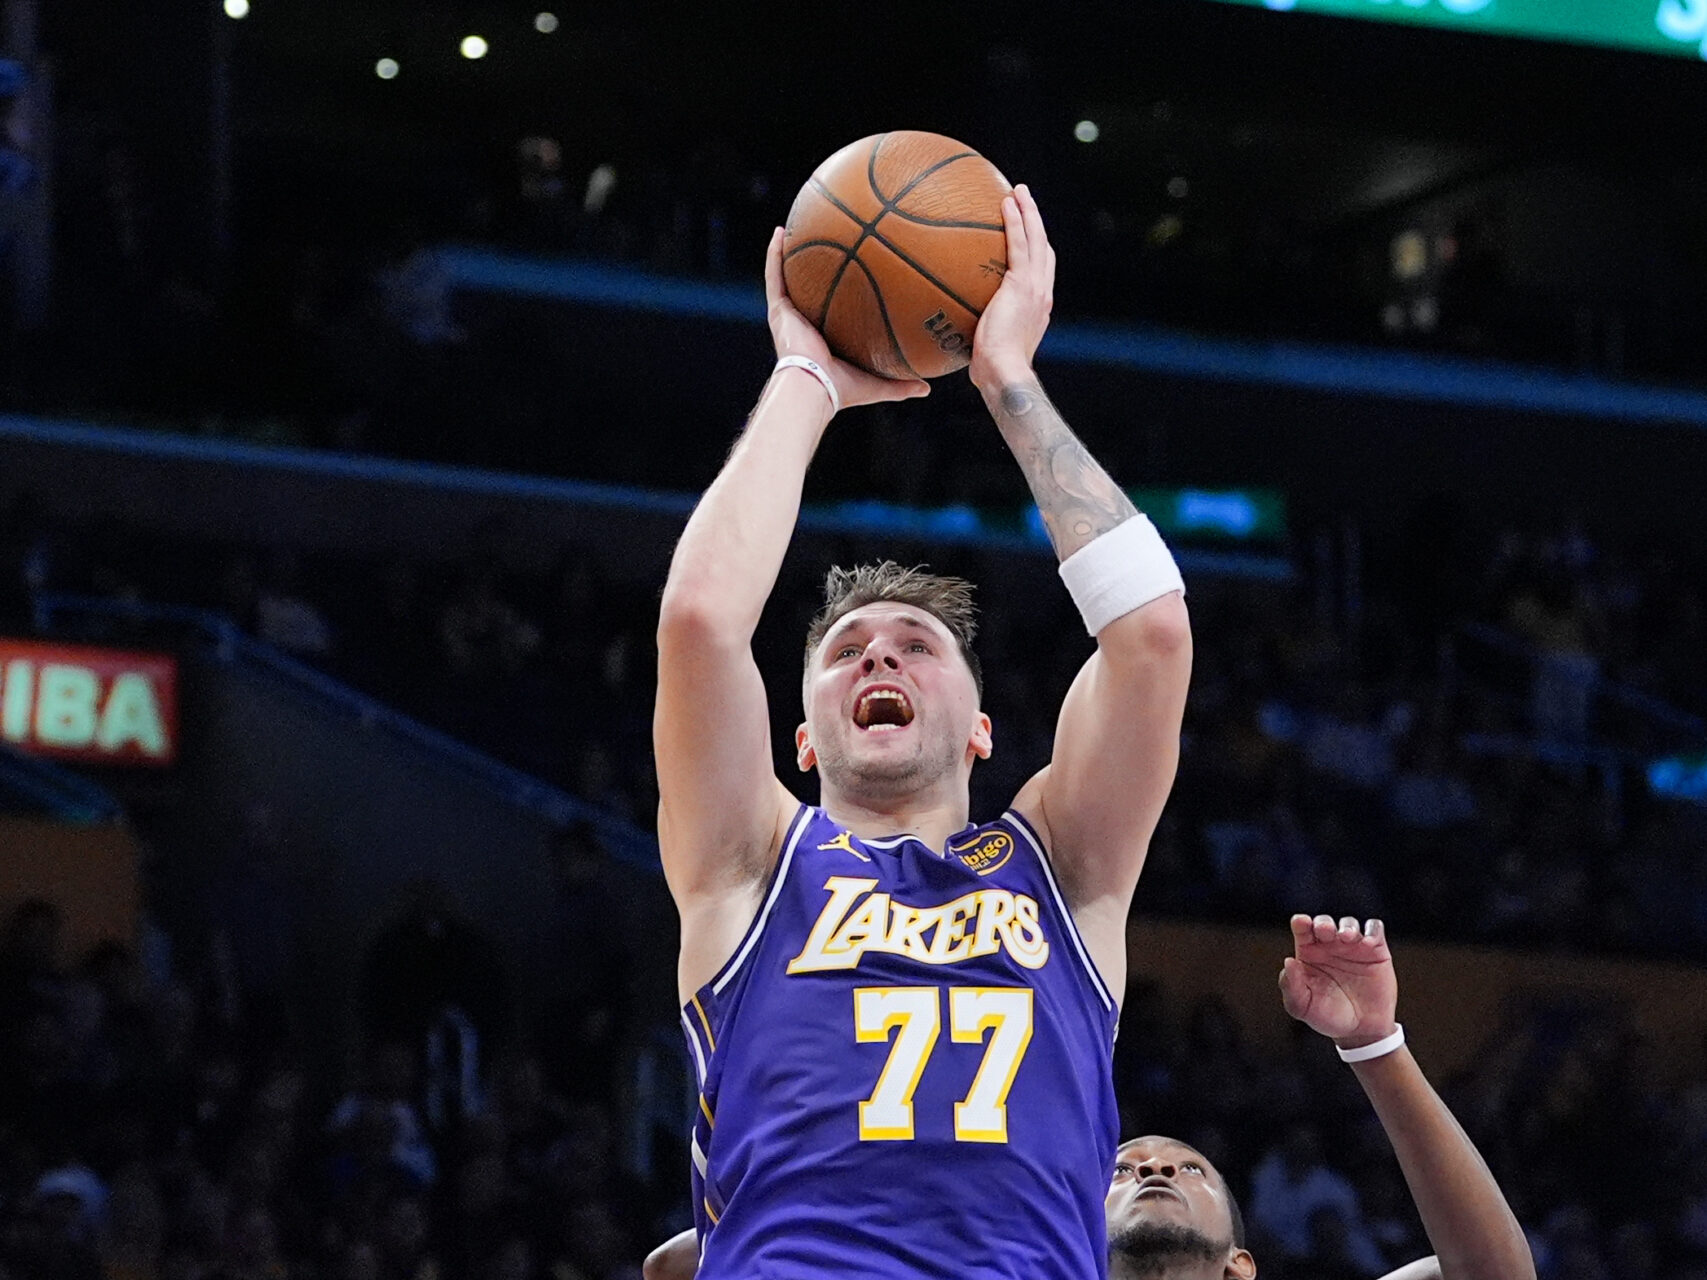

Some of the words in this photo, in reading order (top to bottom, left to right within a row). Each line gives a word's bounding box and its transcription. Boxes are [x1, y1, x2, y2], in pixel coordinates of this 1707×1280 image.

[0, 658, 172, 758] IBA
[786, 876, 1050, 975] LAKERS
[853, 986, 1034, 1144] 77
